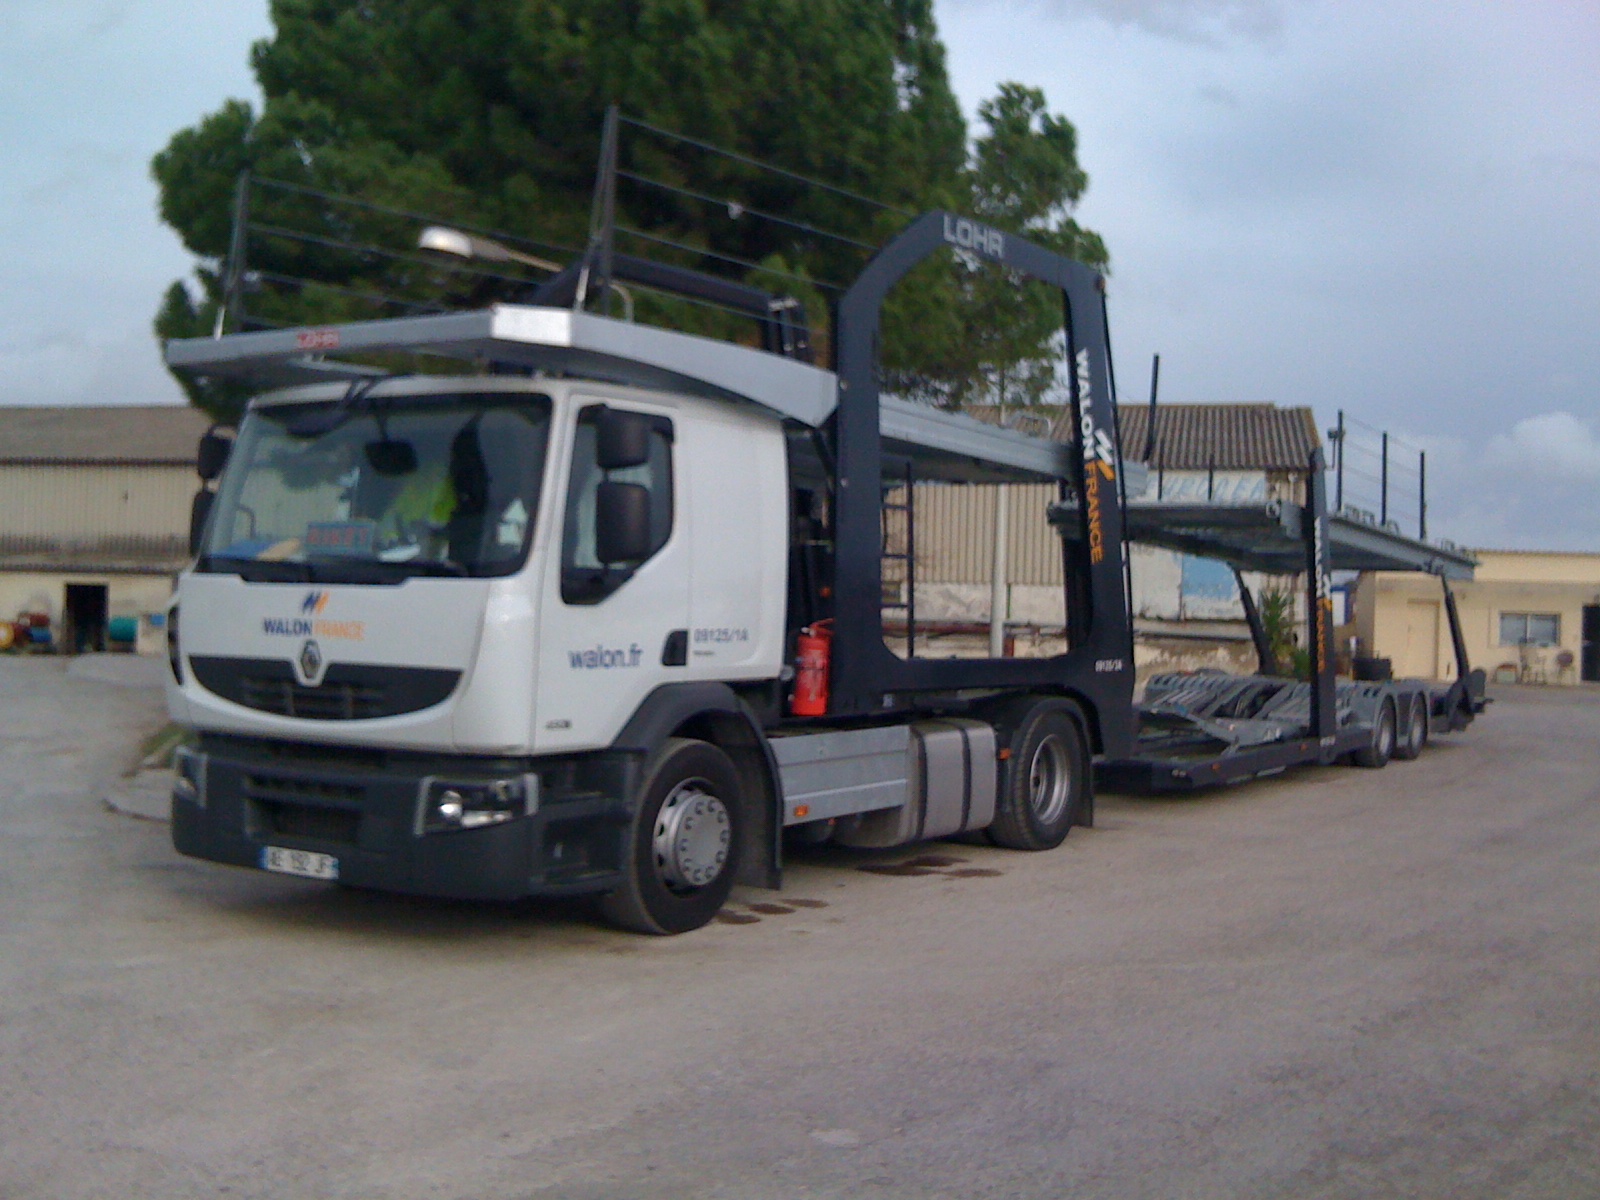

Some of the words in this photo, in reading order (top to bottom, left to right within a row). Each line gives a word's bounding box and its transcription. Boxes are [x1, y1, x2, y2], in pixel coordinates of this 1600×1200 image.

[943, 213, 1004, 258] LOHR
[1076, 348, 1094, 460] WALON
[1084, 461, 1103, 565] FRANCE
[263, 617, 313, 636] WALON
[313, 620, 365, 640] FRANCE
[567, 643, 643, 669] walon.fr
